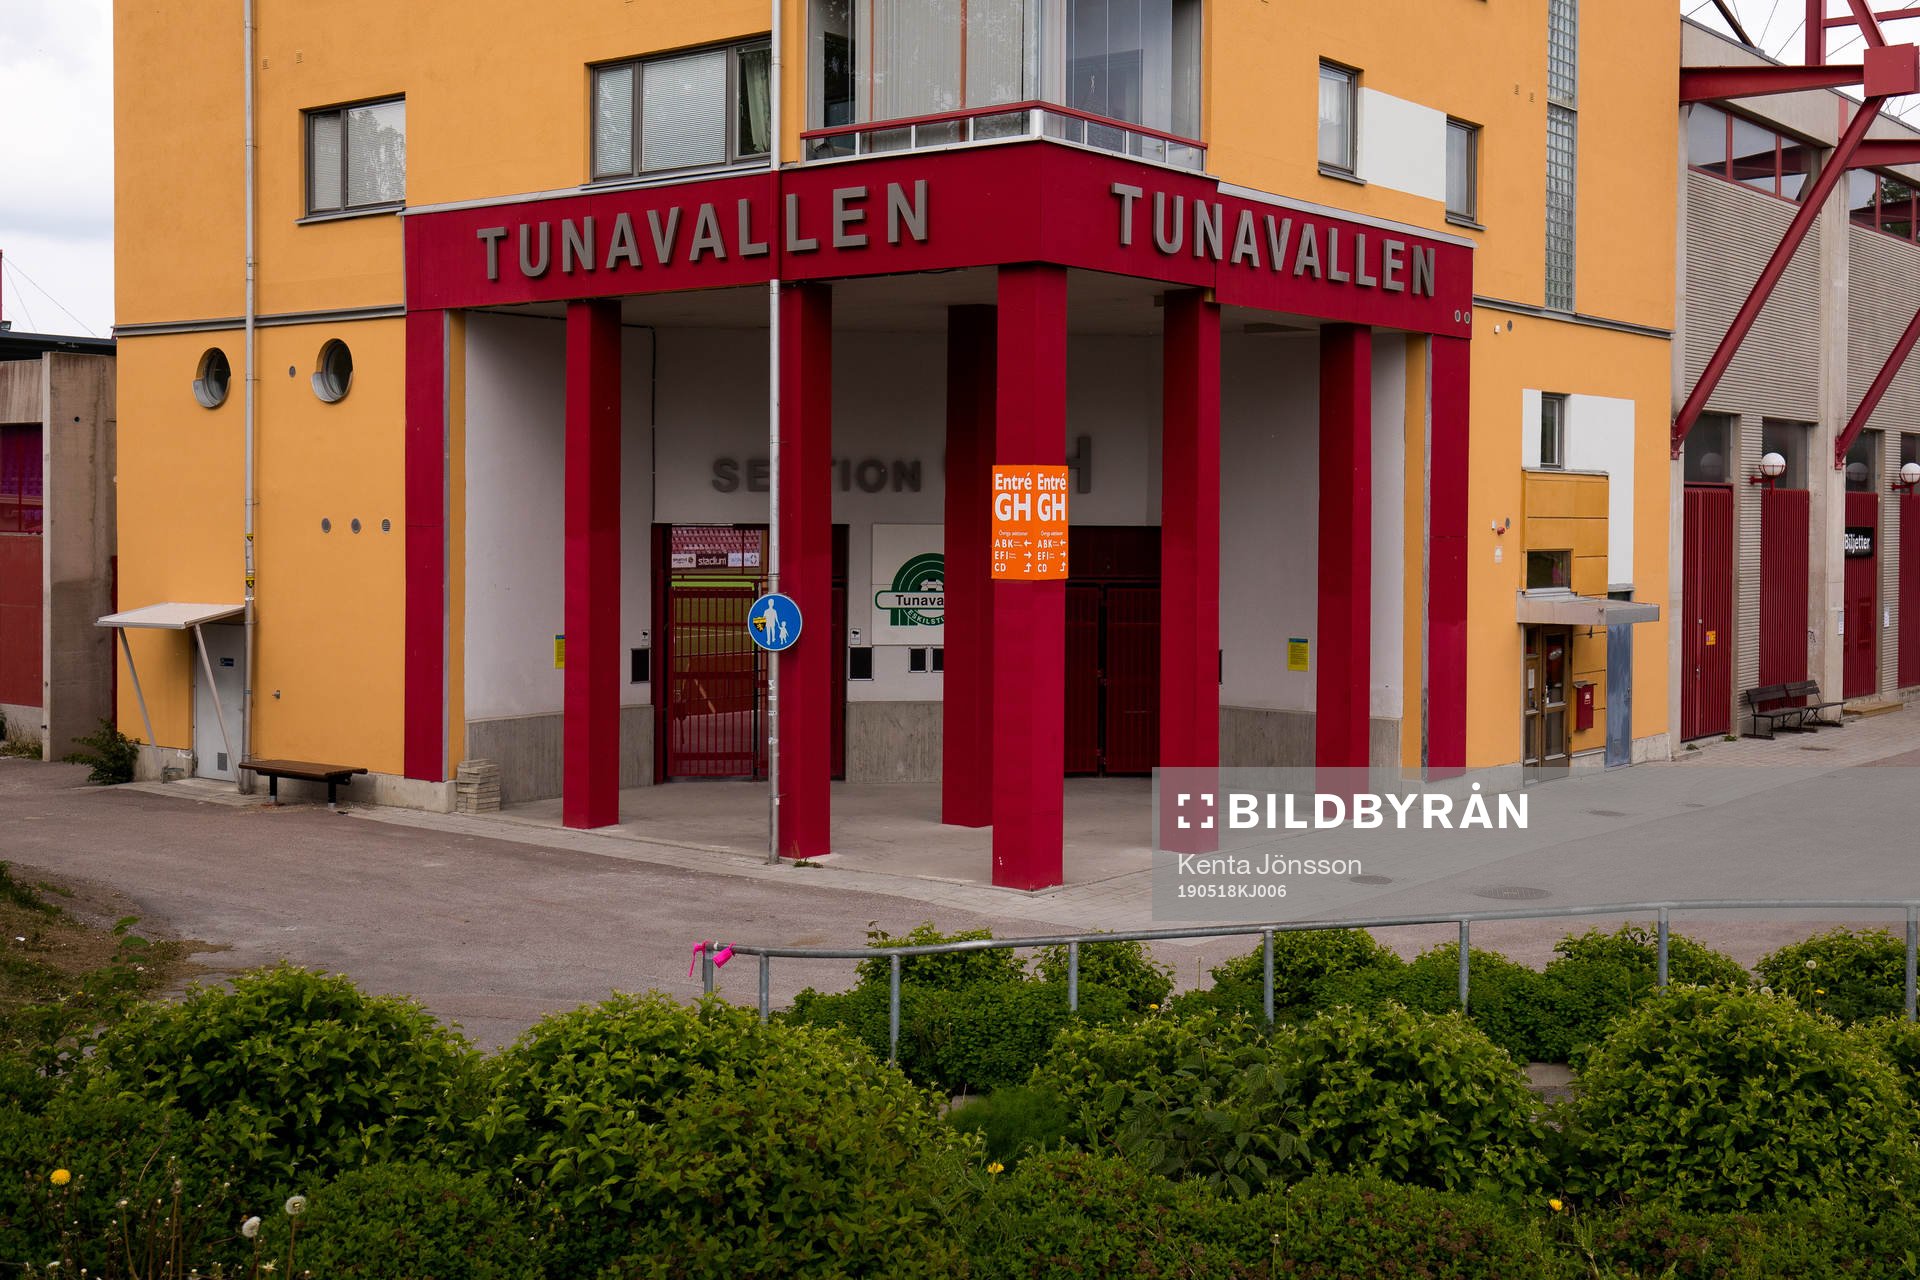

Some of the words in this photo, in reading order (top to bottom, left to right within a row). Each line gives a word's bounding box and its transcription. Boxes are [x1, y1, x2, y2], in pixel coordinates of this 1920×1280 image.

[476, 179, 928, 280] TUNAVALLEN
[1111, 182, 1436, 297] TUNAVALLEN
[711, 457, 922, 494] SEION
[995, 472, 1032, 490] Entré
[1037, 472, 1066, 490] Entré
[995, 493, 1031, 521] GH
[1037, 493, 1066, 521] GH
[1844, 533, 1870, 554] Biljetter
[698, 556, 727, 566] stadium
[994, 563, 1006, 572] CD
[1037, 563, 1047, 573] CD
[907, 609, 944, 625] ESKILST
